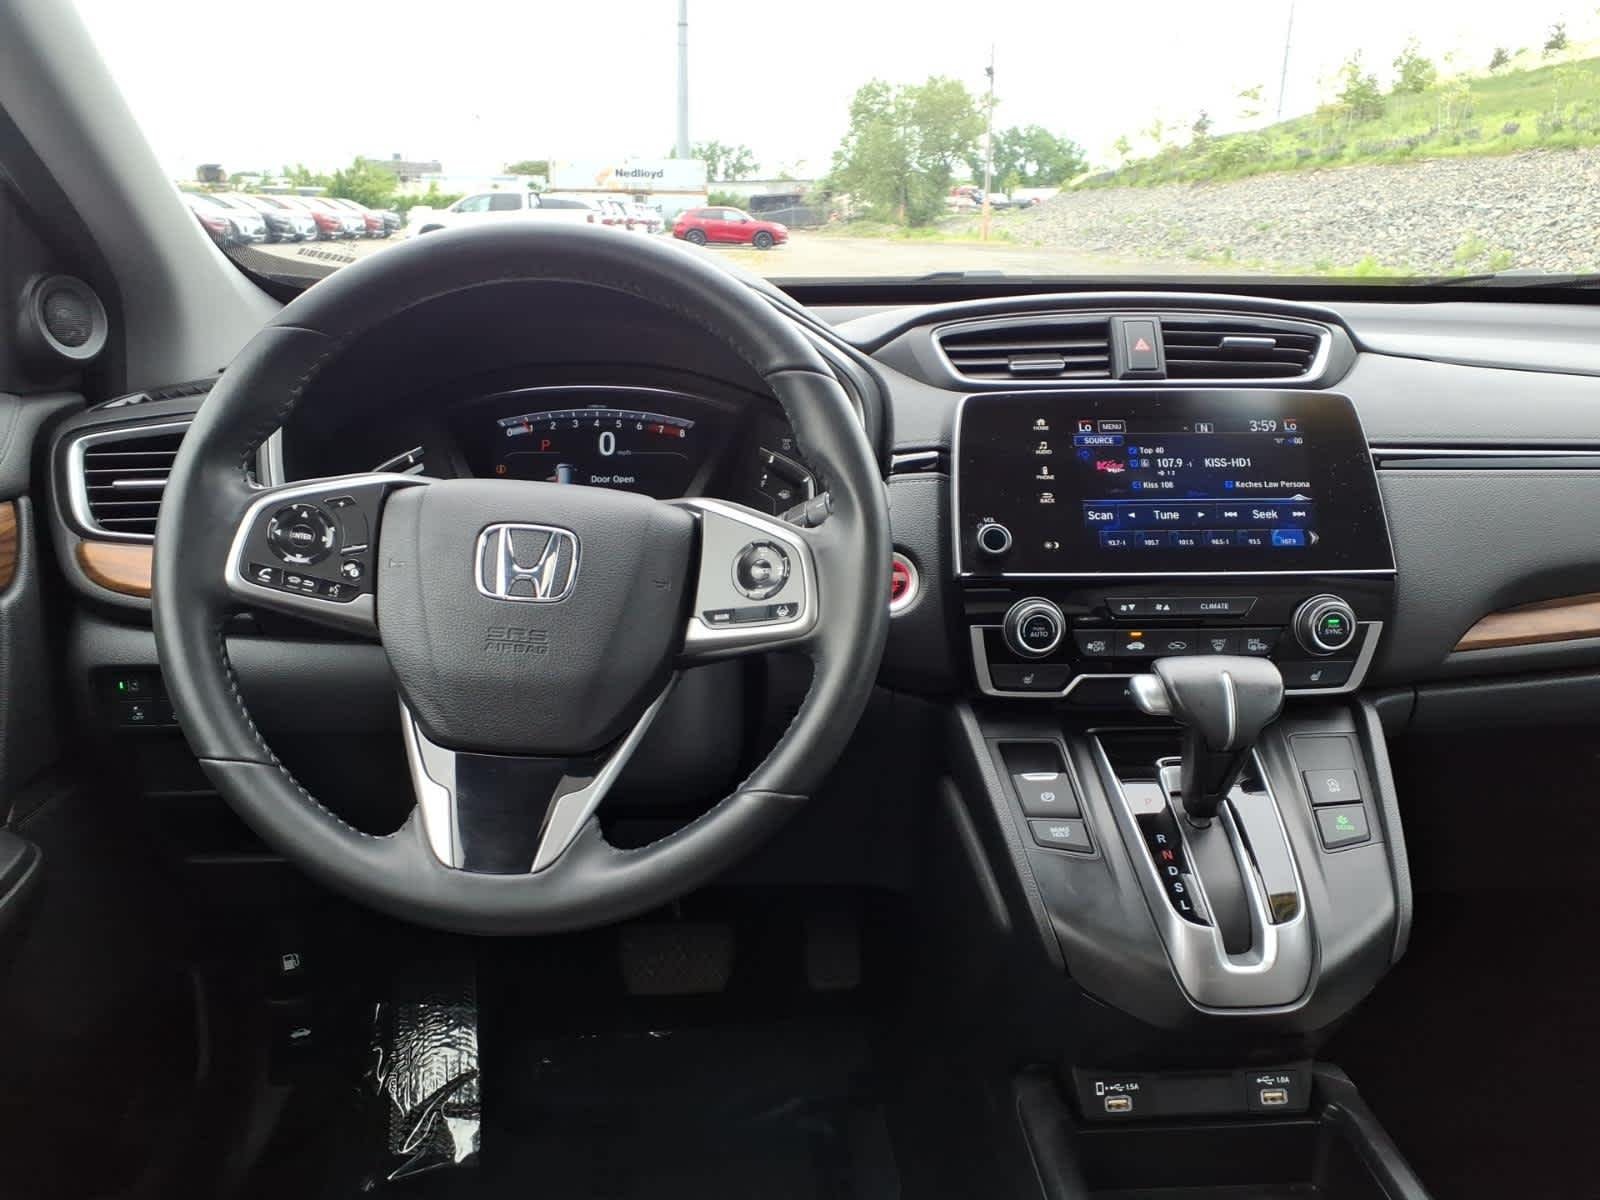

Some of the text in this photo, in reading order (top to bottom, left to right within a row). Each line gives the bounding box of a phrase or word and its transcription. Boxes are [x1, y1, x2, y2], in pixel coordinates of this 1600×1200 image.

[615, 168, 664, 179] Nedlloyd
[573, 420, 579, 428] 3
[594, 420, 600, 428] 4
[616, 420, 622, 428] 5
[636, 422, 642, 430] 6
[679, 429, 686, 438] 8
[1079, 422, 1092, 432] Lo
[1249, 420, 1297, 432] 3:59 Lo
[541, 440, 551, 450] P
[599, 431, 616, 457] 0
[1140, 447, 1154, 455] Top
[1157, 458, 1183, 468] 107.9
[1204, 458, 1252, 467] KISS-HD1
[591, 475, 635, 485] Door Open
[1143, 481, 1158, 489] Kiss
[1088, 511, 1114, 520] Scan
[1153, 510, 1180, 520] Tune
[1252, 509, 1278, 519] Seek
[487, 626, 548, 641] SRS
[1156, 834, 1166, 843] R
[1162, 850, 1174, 859] N
[1168, 866, 1178, 876] D
[1174, 882, 1184, 893] S
[1180, 900, 1190, 911] L
